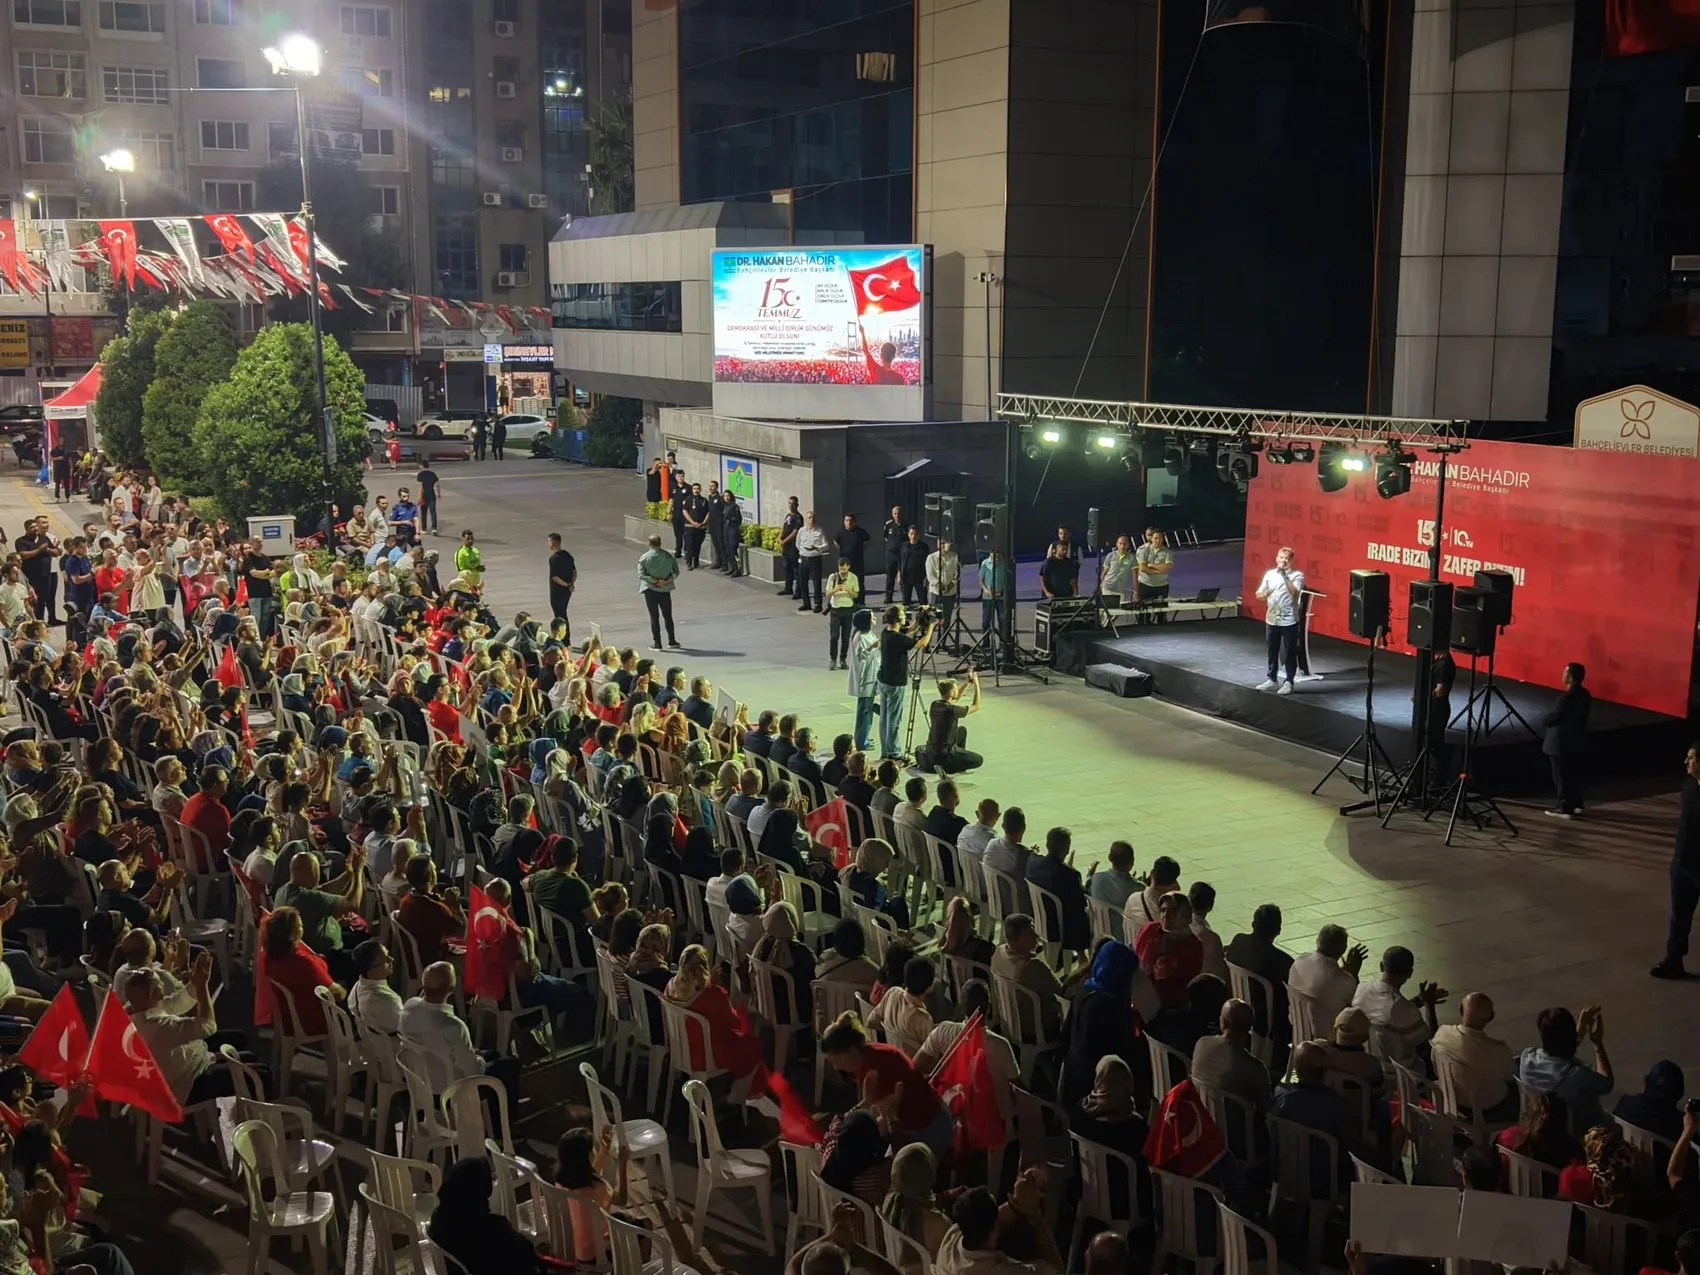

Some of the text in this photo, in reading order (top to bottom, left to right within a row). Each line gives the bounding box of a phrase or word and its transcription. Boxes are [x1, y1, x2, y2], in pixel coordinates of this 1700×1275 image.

[737, 255, 836, 266] DR. HAKAN BAHADIR
[760, 277, 791, 308] 15
[756, 308, 803, 320] TEMMUZ
[1644, 444, 1694, 457] BELEDİYESİ
[1460, 465, 1530, 488] BAHADIR
[1452, 481, 1481, 492] Belediye
[1483, 484, 1509, 495] Başkanı
[1367, 542, 1401, 564] İRADE
[1443, 554, 1481, 577] ZAFER
